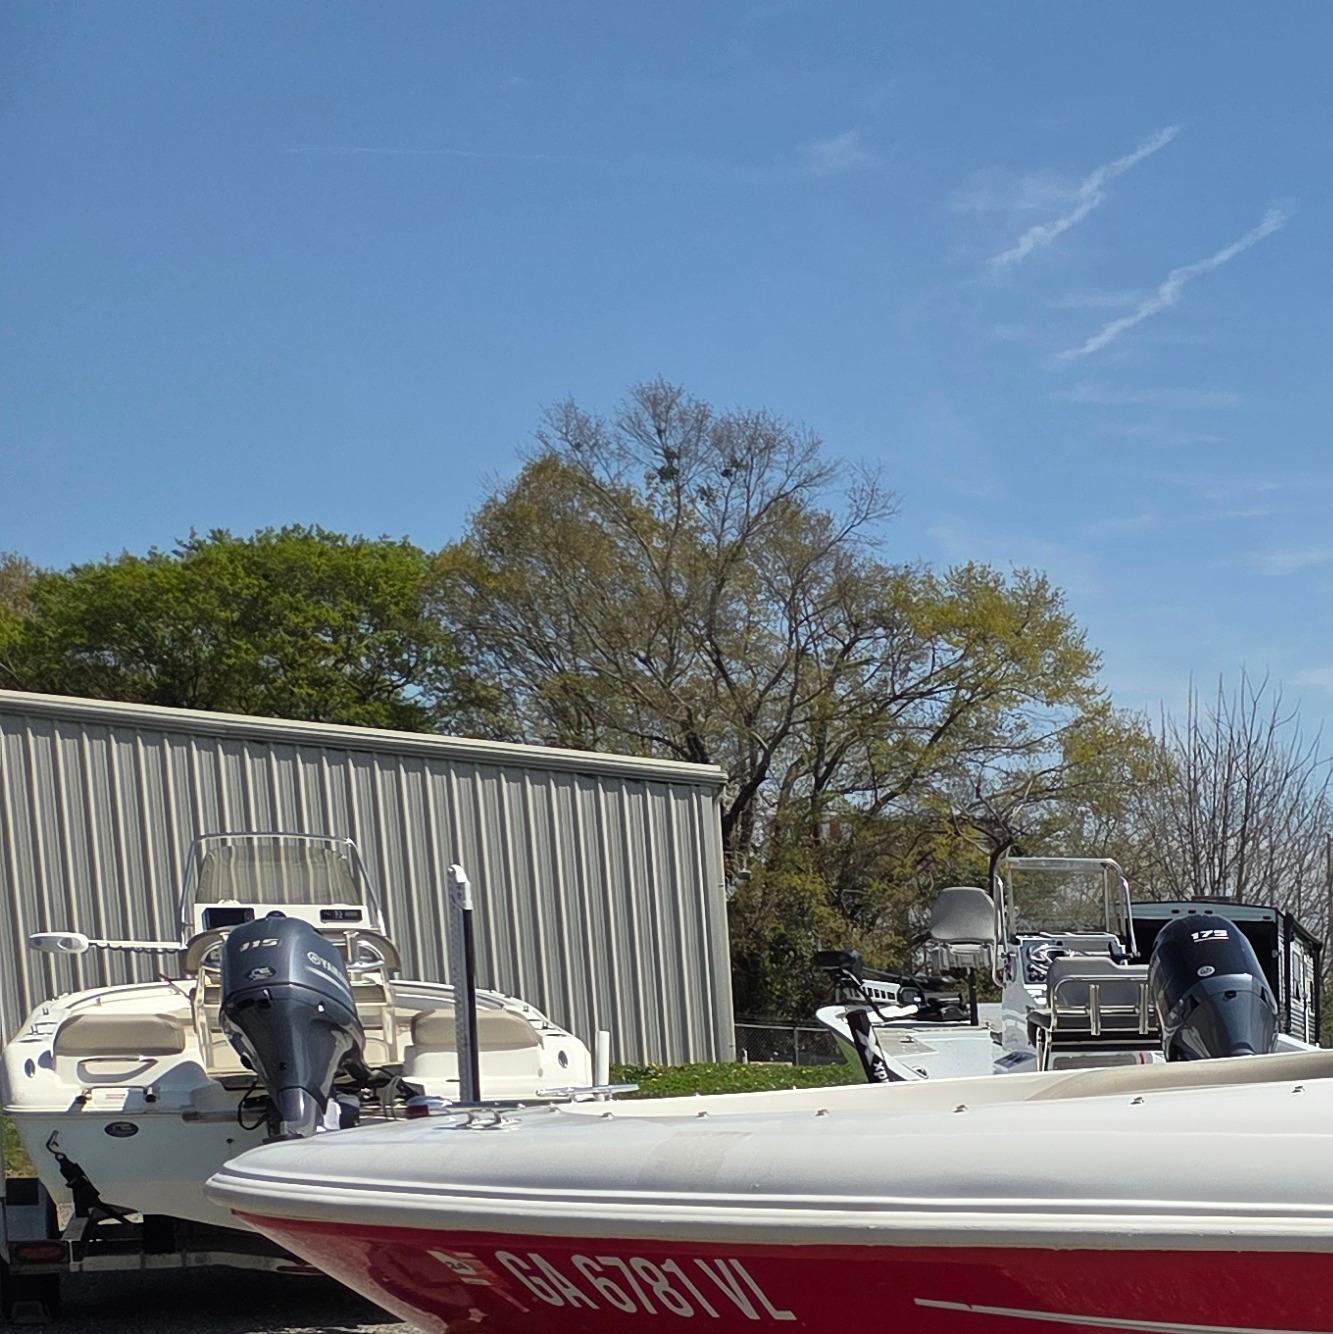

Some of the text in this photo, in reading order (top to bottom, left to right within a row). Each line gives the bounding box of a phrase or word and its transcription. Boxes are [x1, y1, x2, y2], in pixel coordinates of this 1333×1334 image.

[1191, 929, 1229, 940] 175
[240, 938, 279, 952] 115
[495, 1250, 798, 1321] GA 6781 VL
